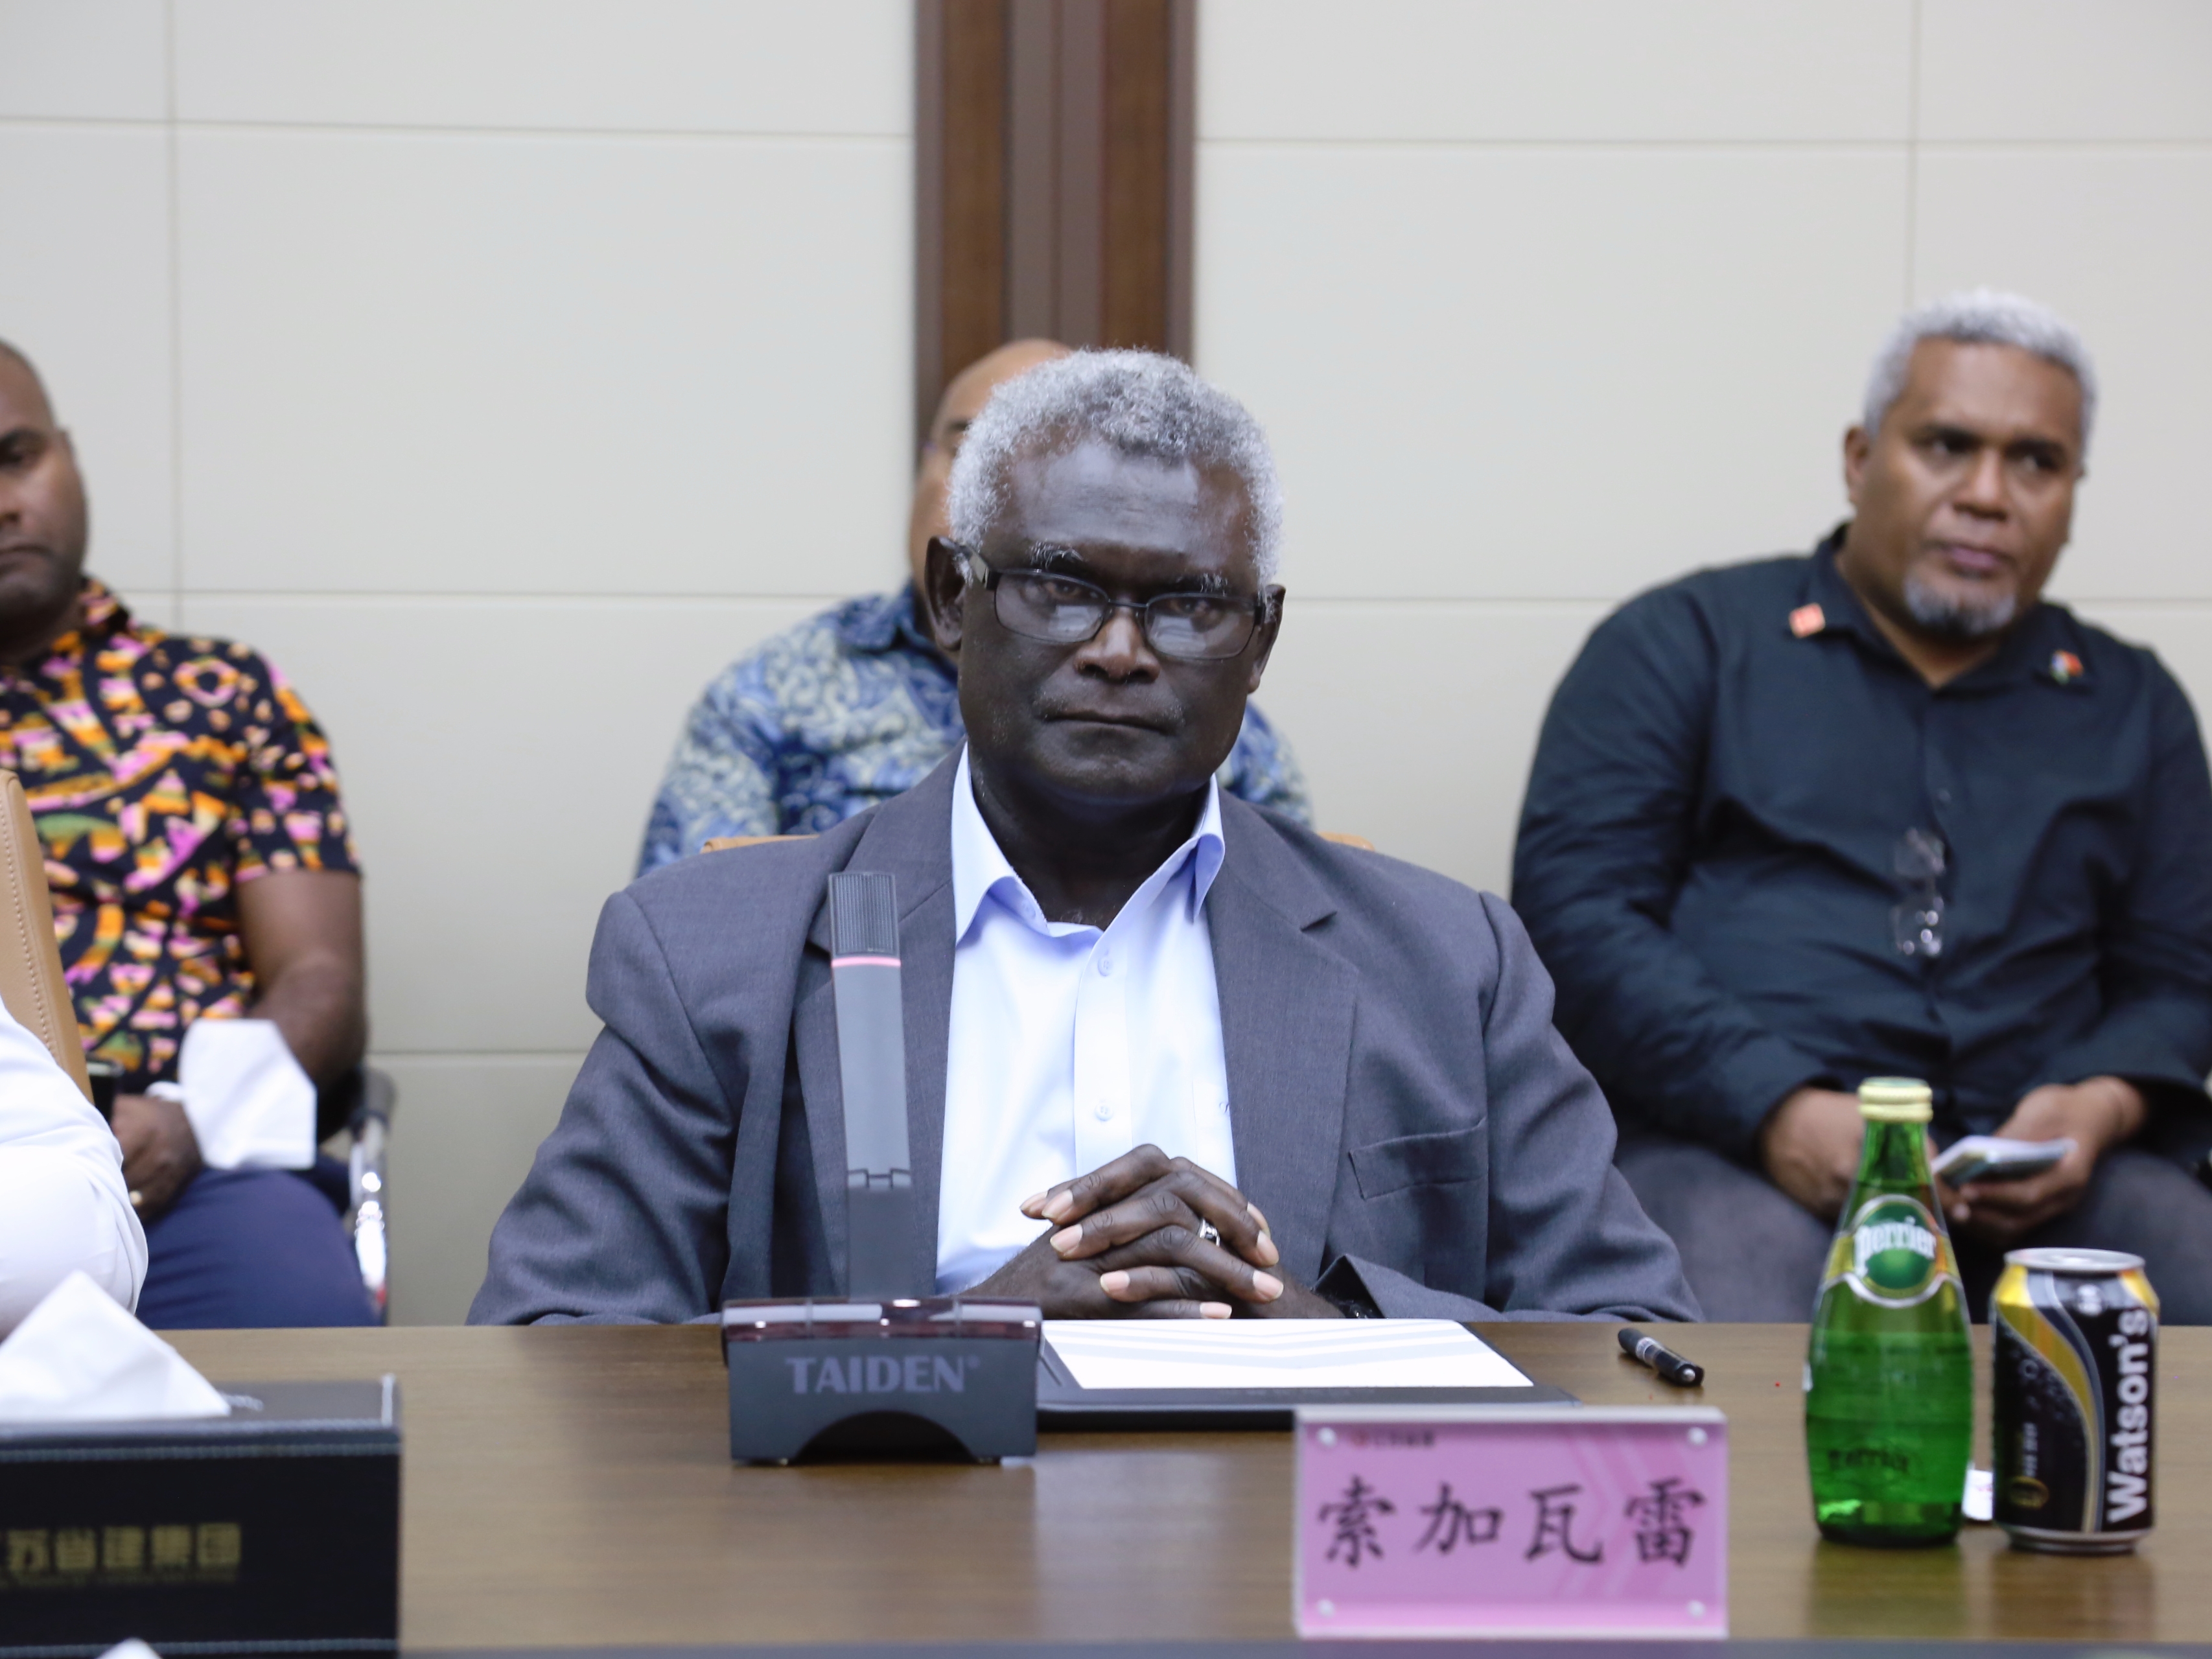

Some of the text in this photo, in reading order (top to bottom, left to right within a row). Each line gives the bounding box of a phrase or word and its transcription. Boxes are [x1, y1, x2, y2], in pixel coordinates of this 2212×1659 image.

[786, 1356, 966, 1395] TAIDEN
[2106, 1306, 2148, 1524] Watson's
[1317, 1474, 1707, 1568] 索加瓦雷
